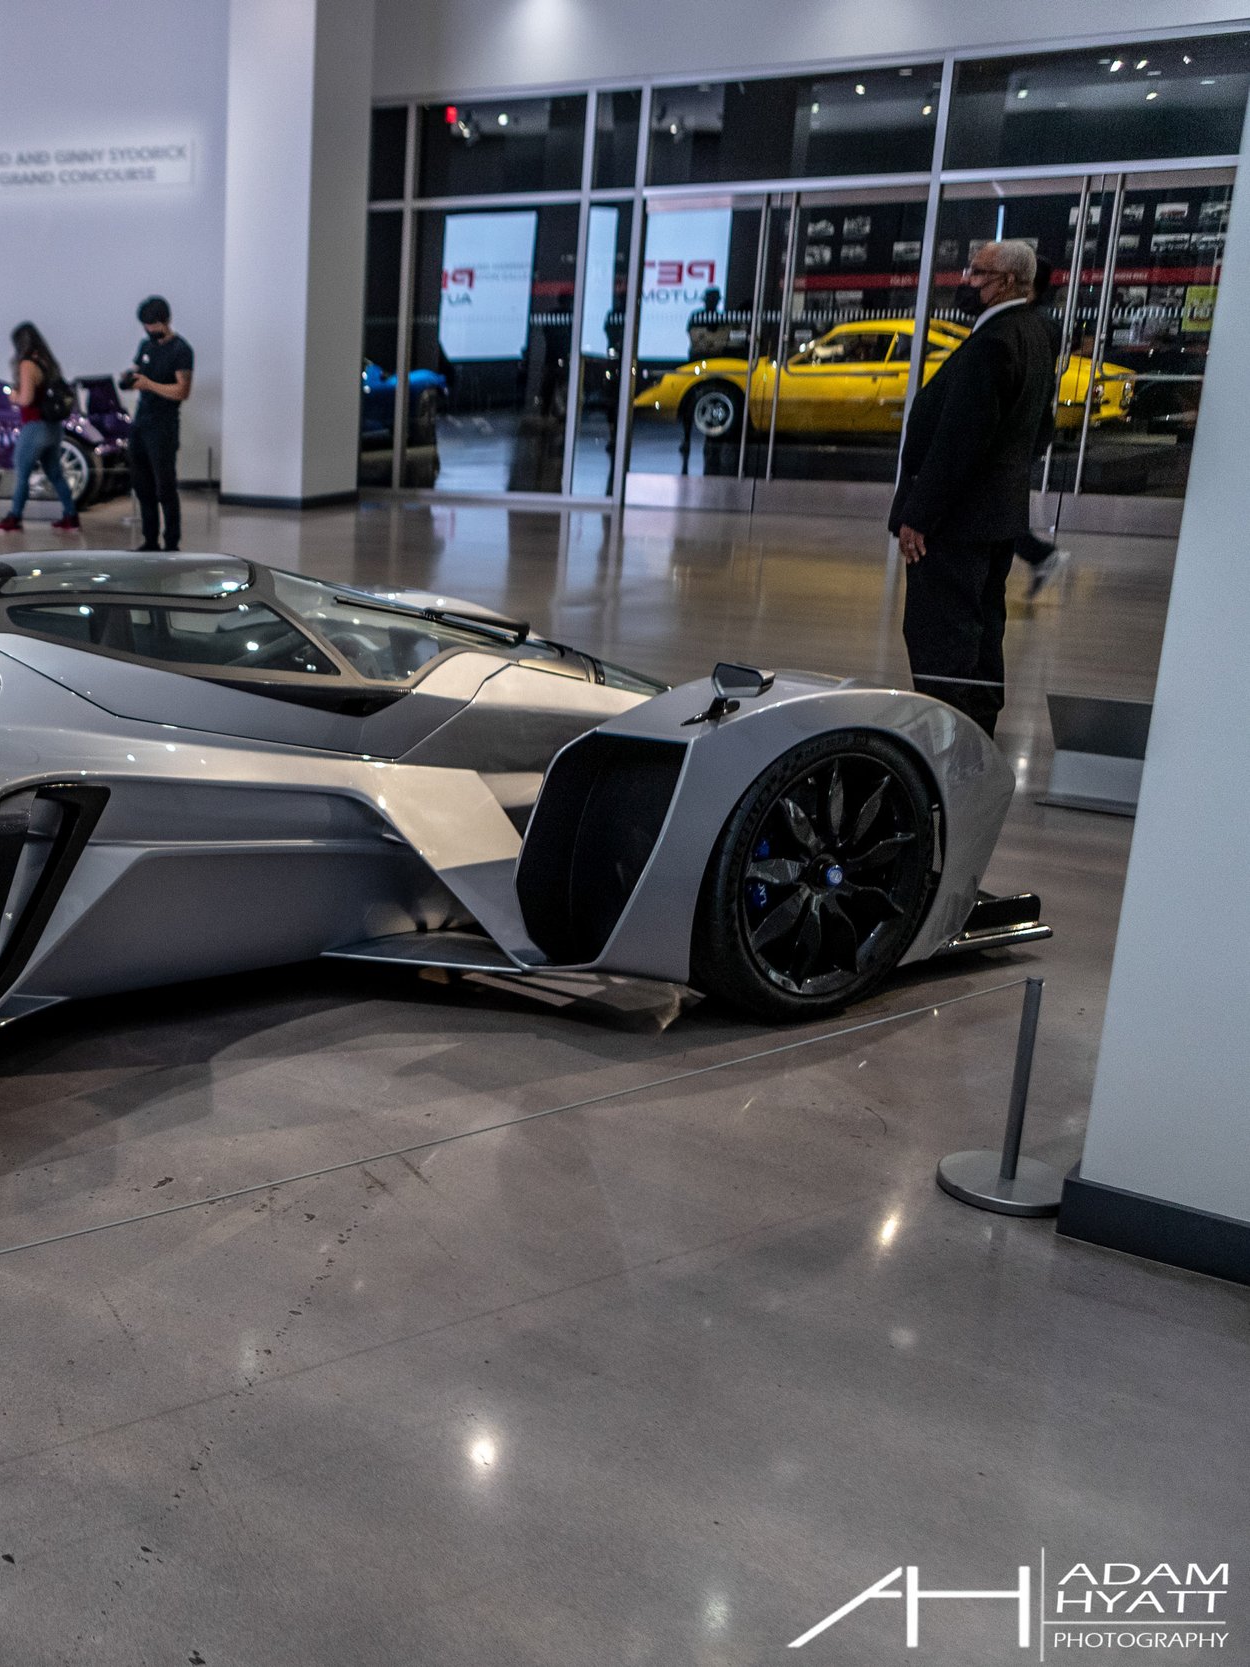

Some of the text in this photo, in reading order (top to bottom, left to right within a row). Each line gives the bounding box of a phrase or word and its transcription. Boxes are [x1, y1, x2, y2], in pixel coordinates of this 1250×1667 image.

[16, 150, 50, 166] AND
[54, 148, 103, 165] GINNY
[58, 167, 156, 184] CONCOURSE
